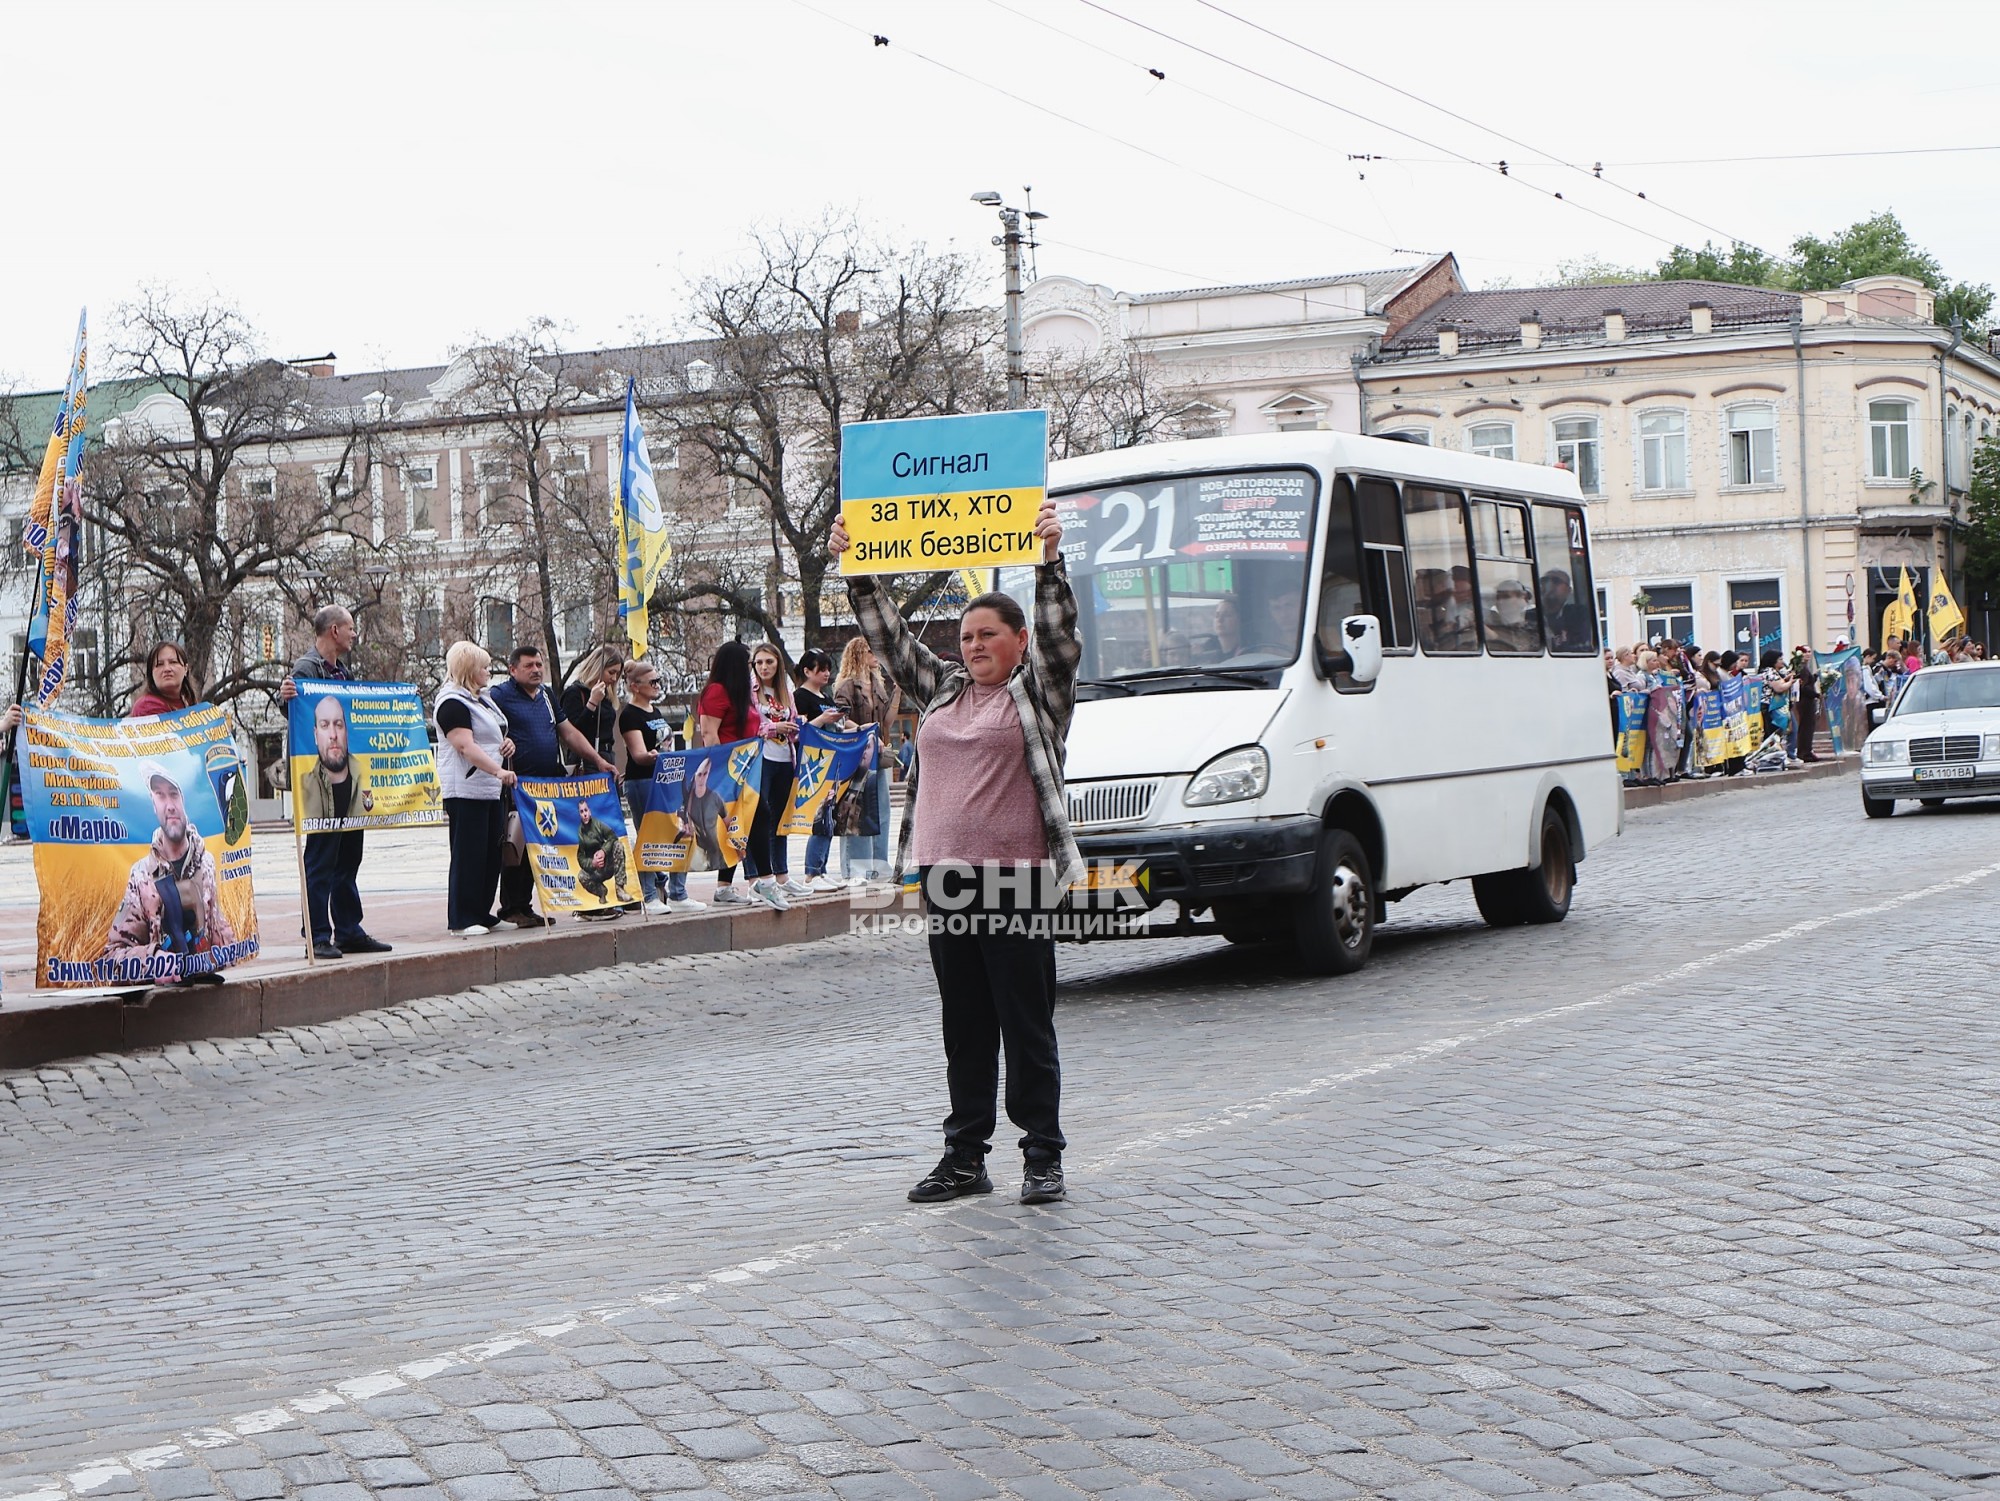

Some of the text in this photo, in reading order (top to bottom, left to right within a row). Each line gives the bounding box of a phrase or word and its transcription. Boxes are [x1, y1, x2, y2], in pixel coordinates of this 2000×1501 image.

[892, 451, 988, 478] Сигнал
[871, 494, 1012, 522] за тих, хто
[1222, 497, 1277, 512] ЦЕНТР
[1094, 487, 1176, 565] 21
[1569, 518, 1584, 548] 21
[855, 528, 1033, 561] зник безвісти
[1205, 542, 1288, 552] ОЗЕРНА БАЛКА
[1106, 565, 1156, 579] mastr
[1106, 579, 1132, 591] zoo
[351, 699, 390, 711] Новиков
[370, 757, 389, 770] ЗНИК
[413, 772, 434, 785] року
[1921, 770, 1934, 778] BA
[1958, 767, 1971, 777] BA
[559, 781, 579, 798] ТЕБЕ
[578, 778, 610, 798] ВДОМА!
[49, 815, 128, 843] «Маріо»
[48, 957, 93, 982] Зник
[95, 952, 184, 982] 11.10.2025
